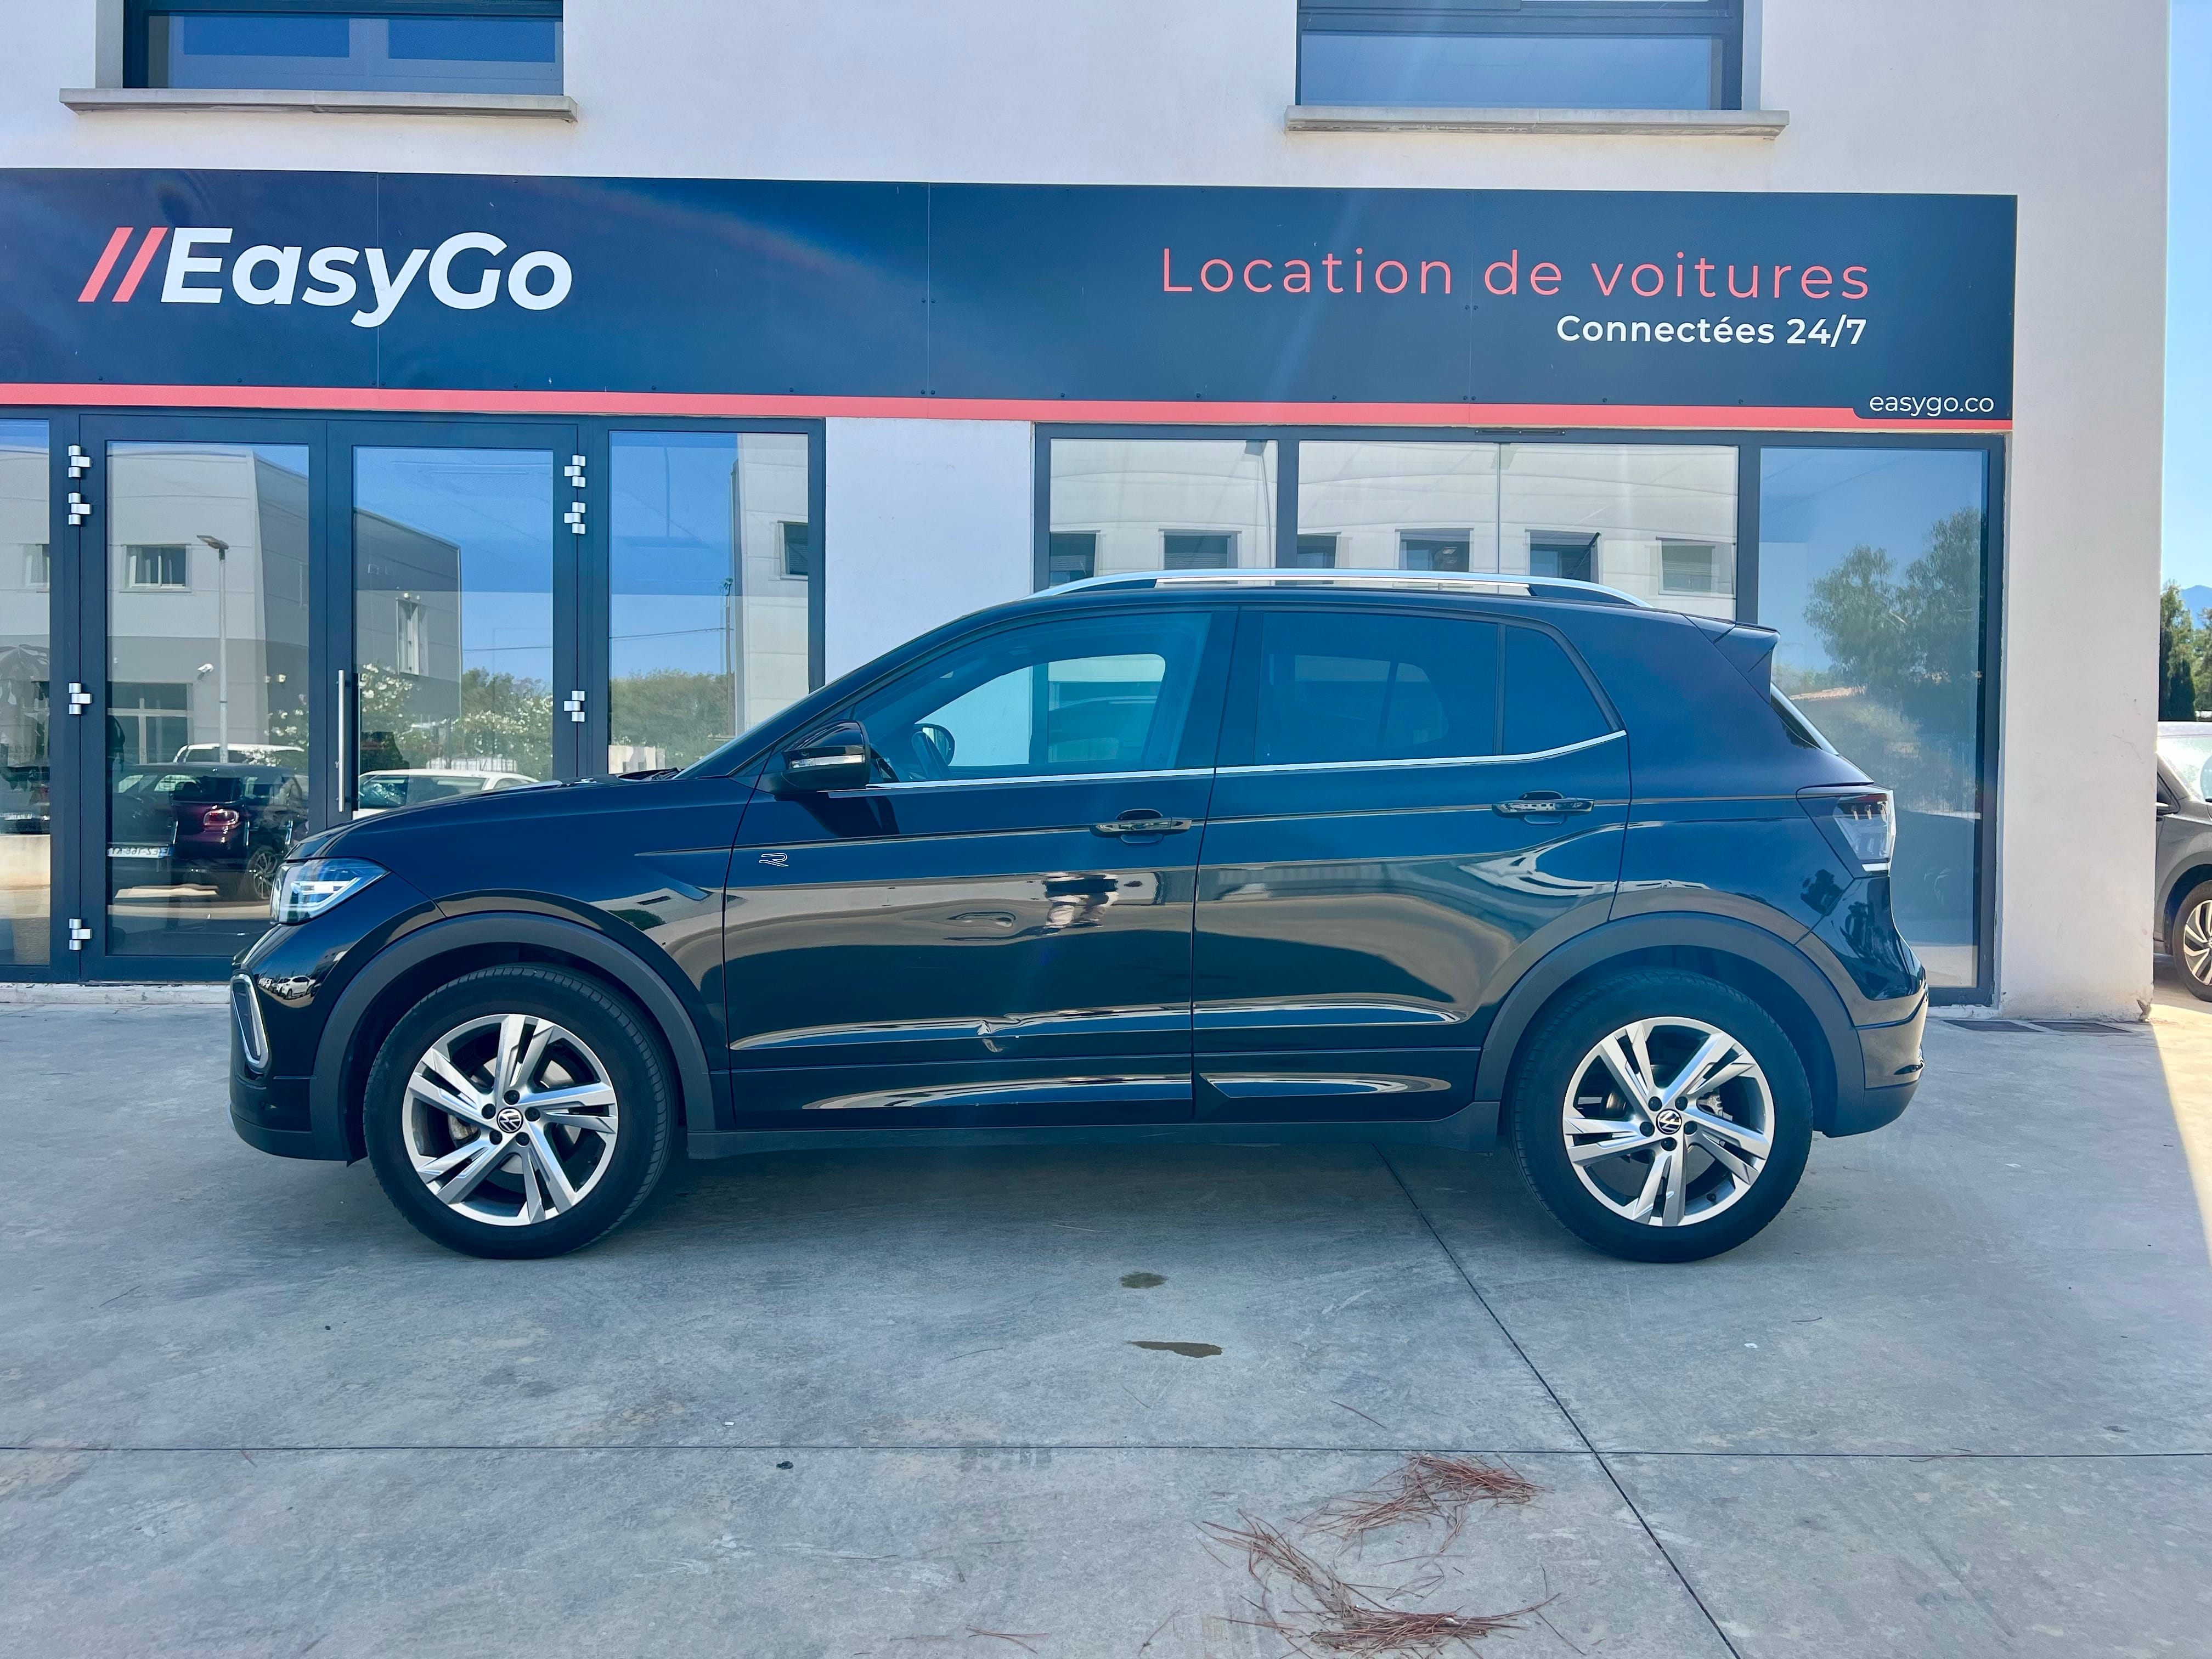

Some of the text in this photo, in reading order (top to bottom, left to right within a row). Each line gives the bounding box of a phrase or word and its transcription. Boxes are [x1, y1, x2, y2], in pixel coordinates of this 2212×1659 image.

[1164, 247, 1868, 300] Location de voitures
[1557, 314, 1866, 348] Connectées 24/7
[1869, 396, 1994, 417] easygo.co
